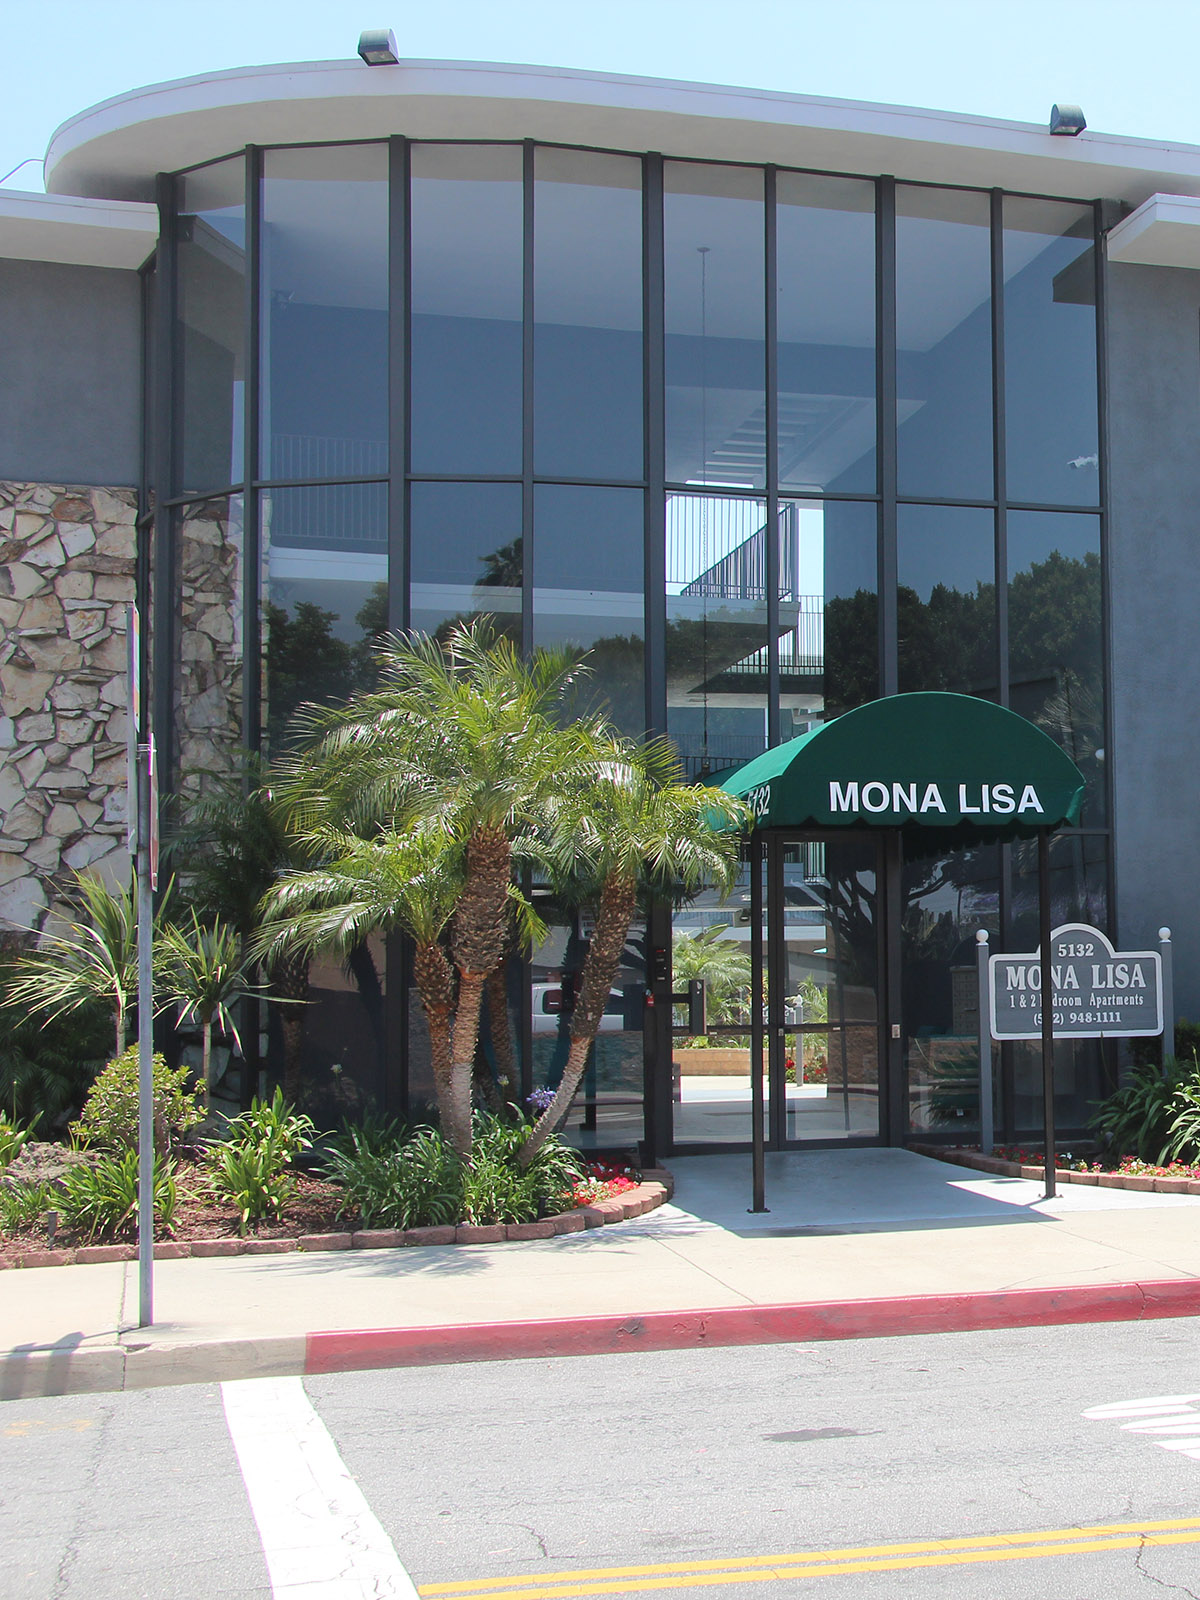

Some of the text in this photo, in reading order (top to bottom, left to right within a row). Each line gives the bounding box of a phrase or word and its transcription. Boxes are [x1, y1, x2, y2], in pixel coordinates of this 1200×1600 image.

[829, 781, 1045, 814] MONA LISA
[1058, 943, 1094, 957] 5132
[1006, 963, 1146, 991] MONA LISA
[1010, 992, 1144, 1008] 1 & 2 droom Apartments
[1033, 1011, 1121, 1026] (52) 948-1111
